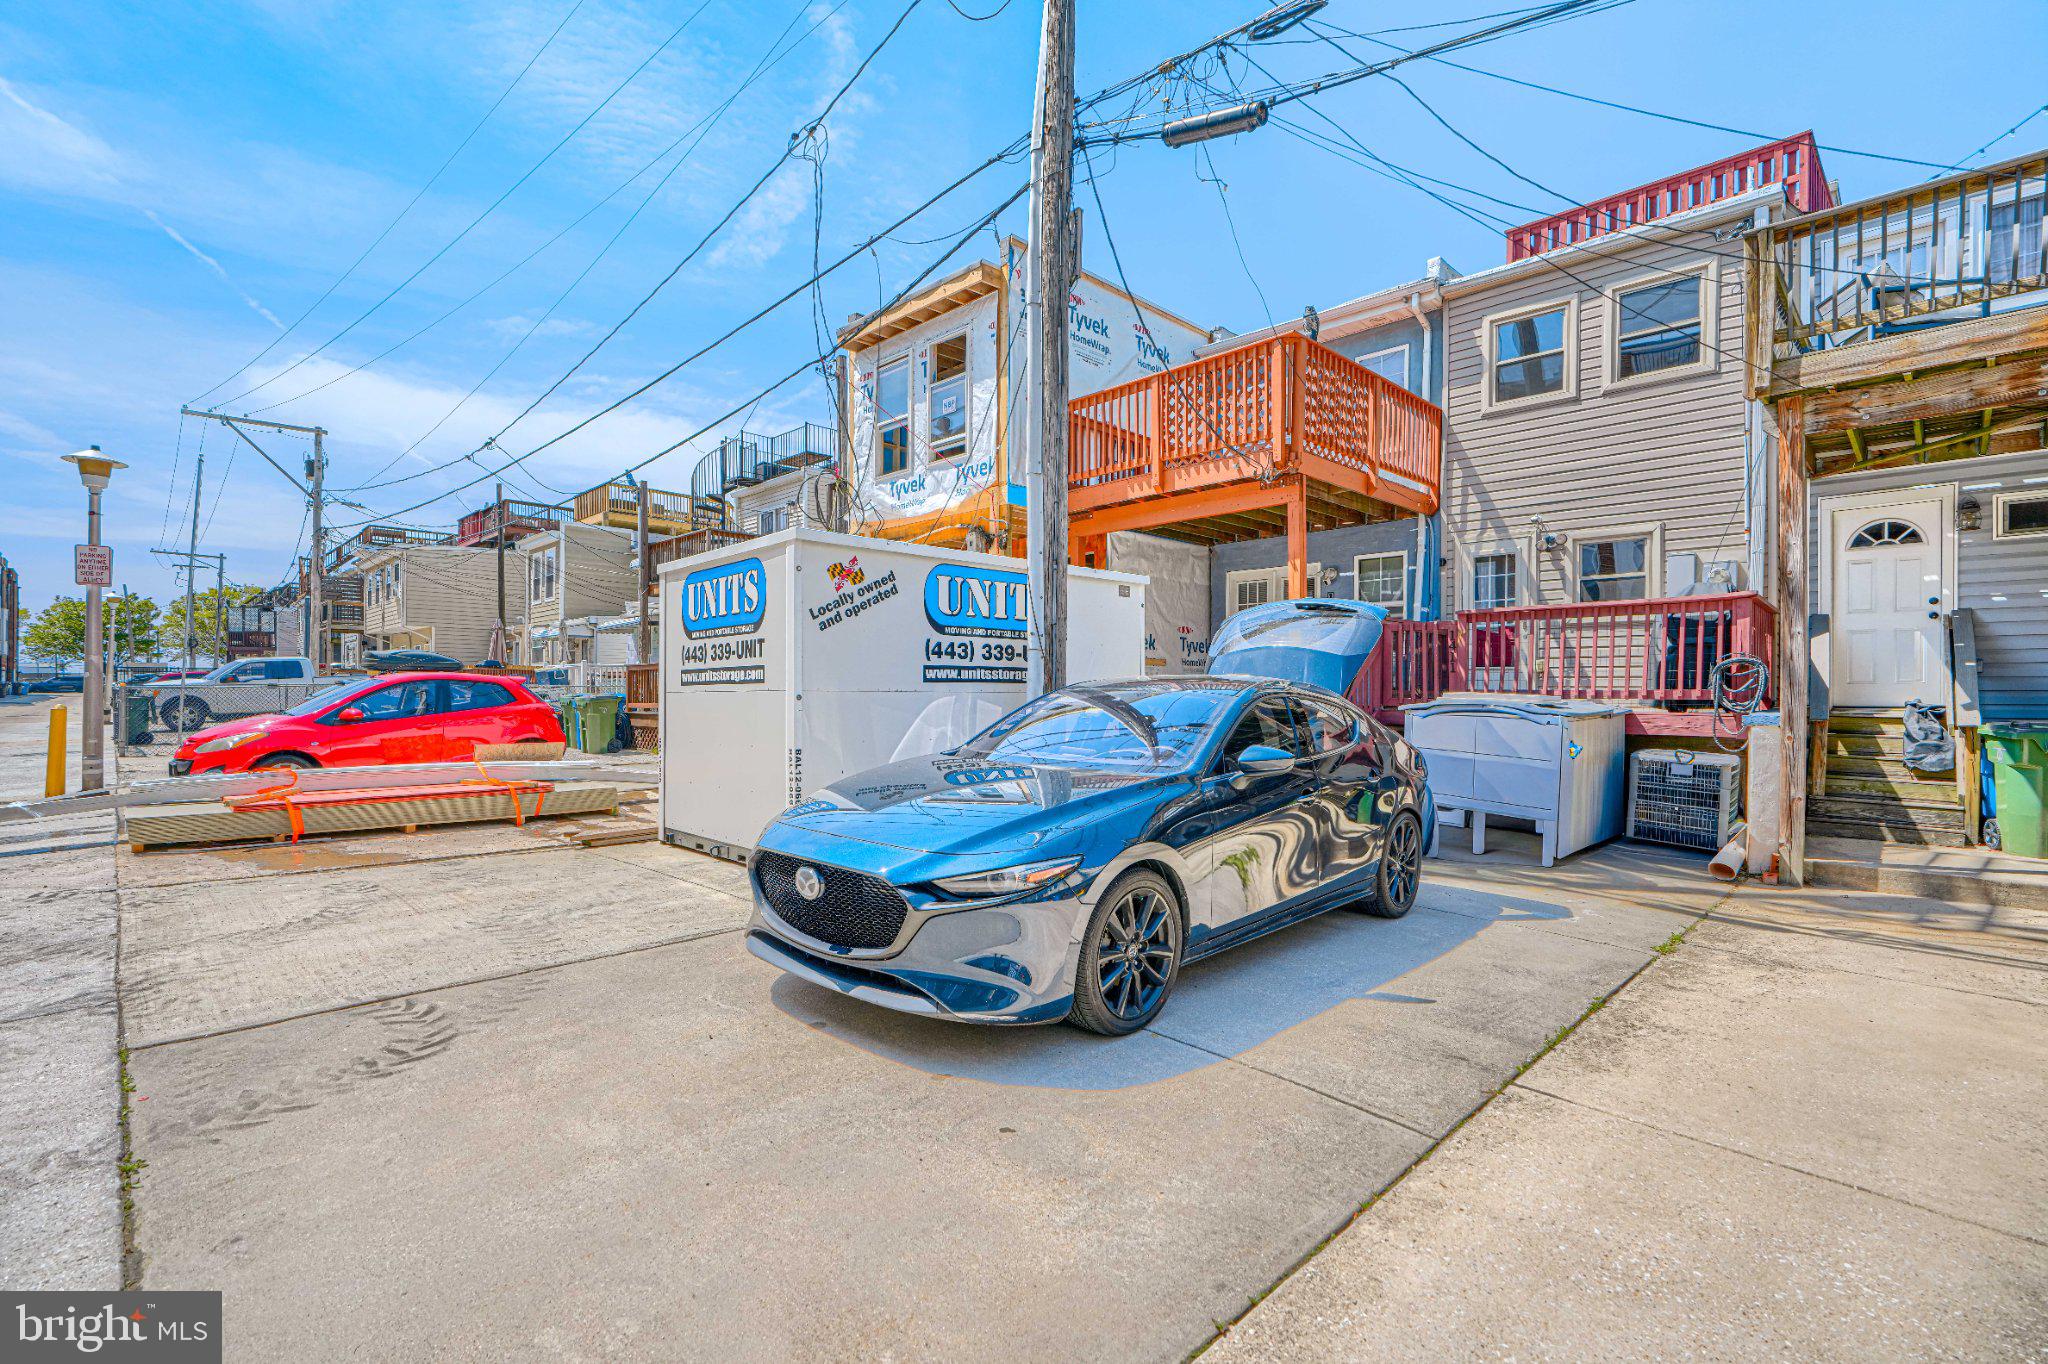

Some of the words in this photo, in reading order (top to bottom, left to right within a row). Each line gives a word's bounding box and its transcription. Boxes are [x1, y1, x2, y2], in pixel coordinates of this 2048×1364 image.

[1068, 305, 1109, 338] Tyvek
[1070, 331, 1111, 356] HomeWrap
[1135, 334, 1170, 365] Tyvek
[889, 477, 926, 499] Tyvek
[687, 569, 759, 622] UNITS
[808, 592, 855, 621] Locally
[857, 570, 897, 598] owned
[818, 613, 843, 632] and
[844, 584, 899, 619] operated
[936, 575, 1028, 621] UNIT
[944, 626, 972, 635] MOVING
[987, 630, 1020, 639] PORTABLE
[681, 642, 708, 666] (443)
[710, 638, 765, 661] 339-UNIT
[925, 638, 975, 662] (443)
[681, 668, 764, 683] www.unitsstorage.com
[925, 668, 1028, 681] www.unitsstorag
